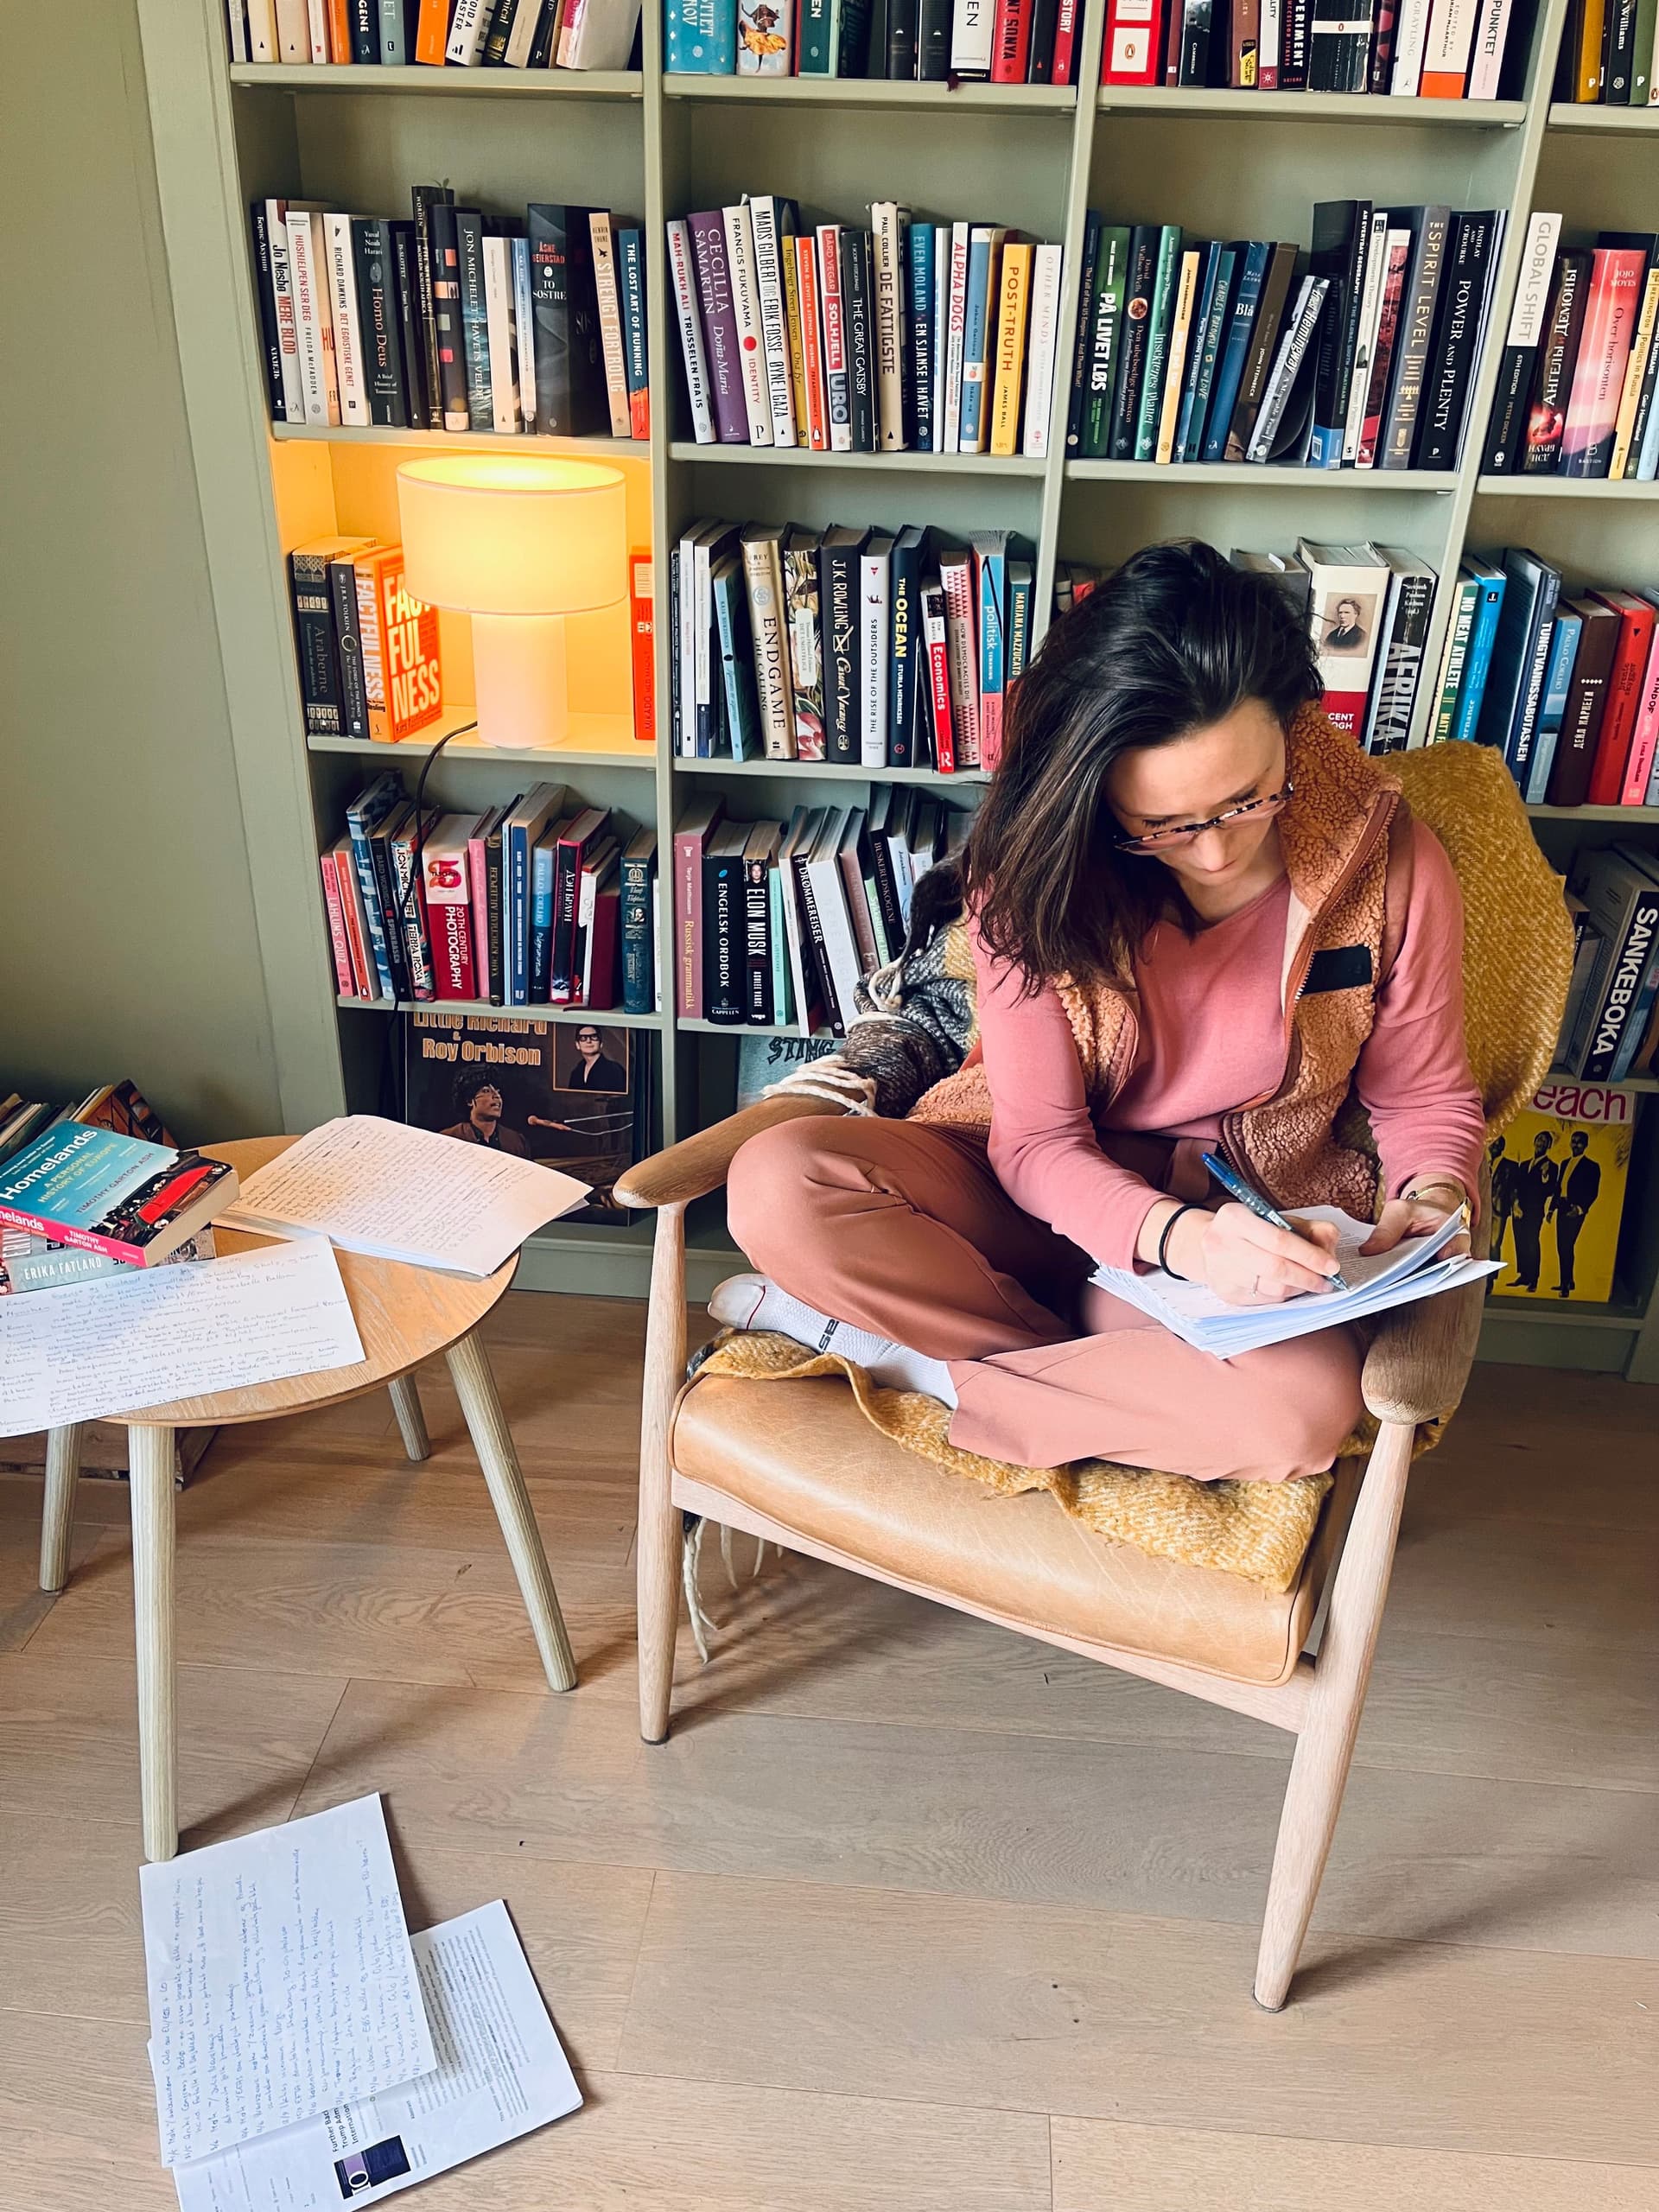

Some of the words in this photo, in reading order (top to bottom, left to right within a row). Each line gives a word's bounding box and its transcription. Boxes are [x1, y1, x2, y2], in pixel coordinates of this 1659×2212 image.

[1618, 7, 1630, 49] Williams
[464, 229, 474, 252] JON
[732, 218, 745, 265] FRANCIS
[754, 211, 771, 240] MADS
[1474, 226, 1485, 258] FINDLAY
[272, 245, 284, 257] Jo
[295, 235, 307, 286] HUSHJELPEN
[334, 247, 344, 276] RICHARD
[627, 243, 637, 263] THE
[757, 244, 776, 283] GILBERT
[913, 236, 925, 264] EVEN
[952, 241, 966, 289] ALPHA
[1421, 232, 1441, 287] SPIRIT
[1527, 221, 1552, 288] GLOBAL
[628, 266, 638, 290] LOST
[694, 231, 715, 315] SAMARTIN
[707, 229, 729, 313] CECILIA
[827, 260, 836, 290] VEGAR
[300, 288, 309, 303] SER
[336, 278, 346, 308] DAWKINS
[596, 263, 616, 320] STRENGT
[629, 294, 639, 313] ART
[736, 269, 752, 327] FUKUYAMA
[914, 267, 927, 310] MOLAND
[1099, 292, 1116, 315] PÅ
[302, 305, 311, 321] DEG
[340, 314, 348, 325] DET
[372, 288, 383, 330] Homo
[631, 316, 639, 328] OF
[764, 299, 779, 321] ERIK
[853, 297, 863, 320] THE
[951, 295, 963, 333] DOGS
[1001, 267, 1020, 372] POST-TRUTH
[1411, 296, 1432, 347] LEVEL
[1449, 280, 1471, 340] POWER
[1518, 294, 1538, 340] SHIFT
[1609, 307, 1624, 338] Over
[376, 334, 387, 366] Deus
[683, 316, 700, 373] TRUSSELEN
[766, 323, 783, 353] FOSSE
[828, 302, 840, 365] SOLHJELL
[854, 323, 865, 354] GREAT
[880, 297, 895, 374] FATTIGSTE
[1095, 318, 1115, 360] LIVET
[1286, 310, 1317, 373] Hemingway
[1634, 336, 1648, 364] Politics
[602, 325, 624, 392] FORTROLIG
[632, 332, 643, 376] RUNNING
[1446, 344, 1456, 365] AND
[1514, 354, 1523, 374] 6TH
[1599, 341, 1620, 401] horisonten
[855, 357, 867, 396] GATSBY
[1090, 363, 1109, 391] LØS
[1510, 375, 1521, 395] EDITION
[1629, 374, 1639, 397] Russia
[831, 373, 848, 423] URO
[917, 387, 929, 419] HAVET
[1433, 369, 1457, 430] PLENTY
[832, 560, 847, 581] J.K.
[342, 604, 351, 632] TOLKIEN
[1014, 592, 1026, 628] MARIANA
[1462, 596, 1475, 612] NO
[355, 580, 384, 700] FACTFULNESS
[894, 598, 907, 658] OCEAN
[983, 606, 998, 650] politisk
[1454, 615, 1472, 643] MEAT
[1560, 628, 1575, 655] PAULO
[315, 626, 328, 693] Araberne
[388, 619, 424, 674] FUL
[754, 637, 763, 660] THE
[1012, 631, 1024, 676] MAZZUCATO
[763, 618, 785, 729] ENDGAME
[836, 657, 850, 692] Casual
[932, 645, 949, 710] Economics
[1445, 648, 1465, 689] ATHLETE
[1554, 657, 1569, 690] COELHO
[393, 659, 439, 722] NESS
[756, 663, 768, 711] CALLING
[870, 683, 878, 694] OF
[1373, 642, 1421, 741] AFRIKA
[1516, 622, 1553, 761] TUNGTVANNSSABOTASJEN
[836, 692, 850, 732] Vacancy
[1440, 713, 1450, 733] MATT
[396, 849, 406, 869] JON
[537, 863, 546, 890] PAULO
[874, 842, 895, 924] BUSKERUDSKOGENE
[327, 897, 343, 937] LAHLUMS
[455, 906, 465, 929] 20TH
[537, 891, 546, 924] COELHO
[563, 893, 574, 922] БРАУН
[718, 883, 728, 933] ENGELSK
[747, 888, 766, 918] ELON
[798, 868, 823, 944] DRØMMEREISER
[870, 895, 883, 944] Sykkelturer
[334, 940, 346, 963] QUIZ
[407, 925, 419, 954] TERRA
[445, 906, 462, 989] PHOTOGRAPHY
[459, 931, 468, 965] CENTURY
[684, 921, 693, 954] Russisk
[747, 922, 766, 956] MUSK
[719, 938, 729, 987] ORDBOK
[683, 957, 694, 1009] grammatikk
[1592, 907, 1657, 1055] SANKEBOKA
[413, 1012, 464, 1029] Little
[467, 1014, 548, 1035] Richard
[452, 1031, 461, 1040] &
[423, 1038, 459, 1062] Roy
[461, 1040, 541, 1066] Orbison
[767, 1037, 836, 1065] STING
[0, 1129, 99, 1200] Homelands
[37, 1178, 72, 1203] HISTORY
[73, 1166, 86, 1179] OF
[86, 1143, 118, 1168] EUROPE
[55, 1151, 93, 1185] PERSONAL
[75, 1186, 109, 1214] TIMOTHY
[110, 1165, 138, 1190] GARTON
[138, 1152, 155, 1165] ASH
[64, 1236, 92, 1248] GARTON
[95, 1243, 108, 1254] ASH
[69, 1230, 99, 1244] TIMOTHY
[24, 1263, 55, 1281] ERIKA
[59, 1256, 102, 1275] FATLAND
[327, 2126, 339, 2152] Further
[339, 2126, 348, 2149] Trump
